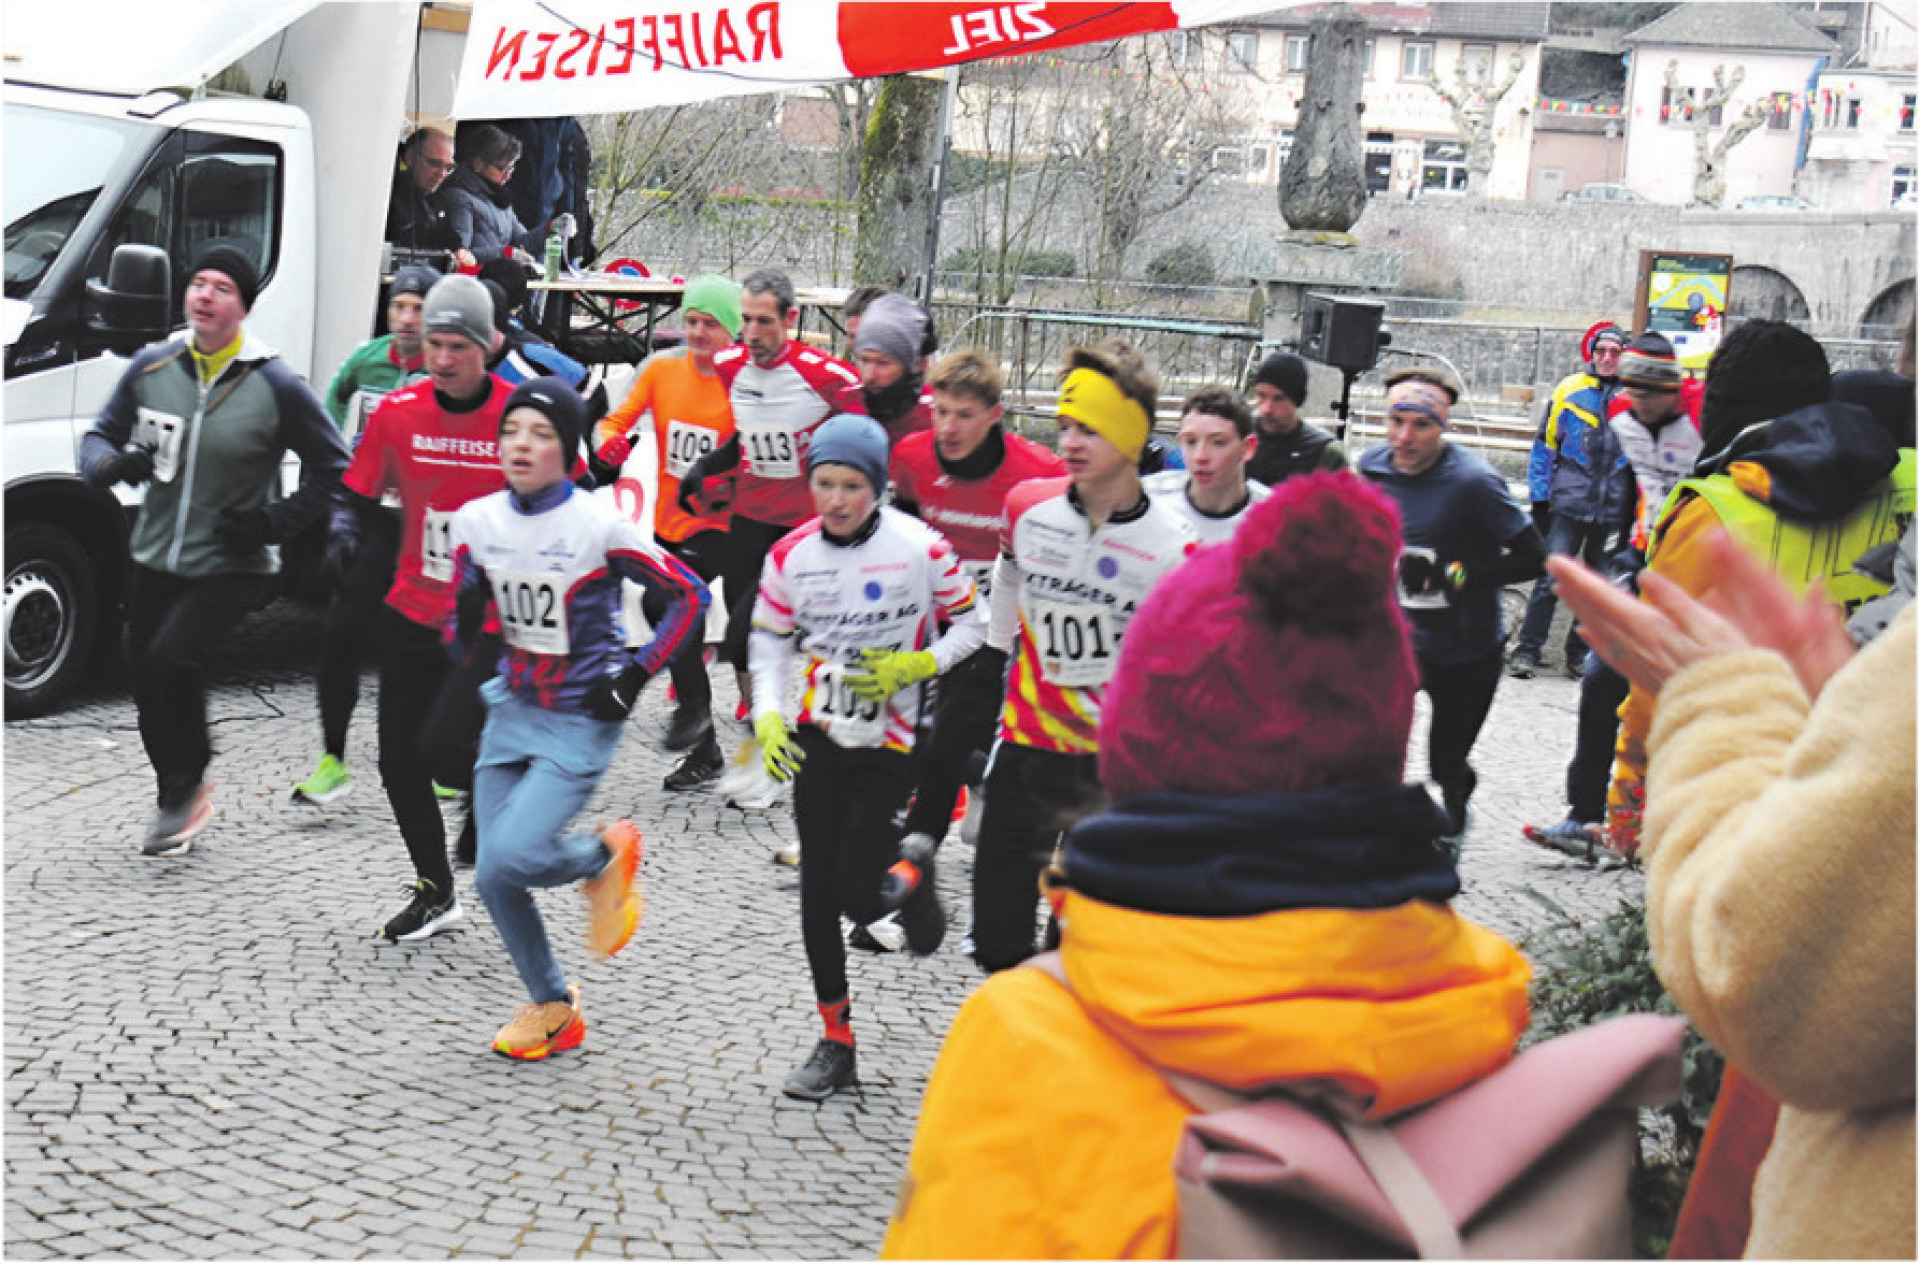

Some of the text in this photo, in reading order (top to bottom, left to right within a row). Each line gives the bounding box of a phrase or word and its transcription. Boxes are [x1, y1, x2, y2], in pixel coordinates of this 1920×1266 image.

[413, 434, 502, 457] RAIFFEISE
[751, 431, 792, 461] 113
[426, 520, 450, 558] 11
[502, 580, 558, 628] 102
[1043, 611, 1110, 661] 101
